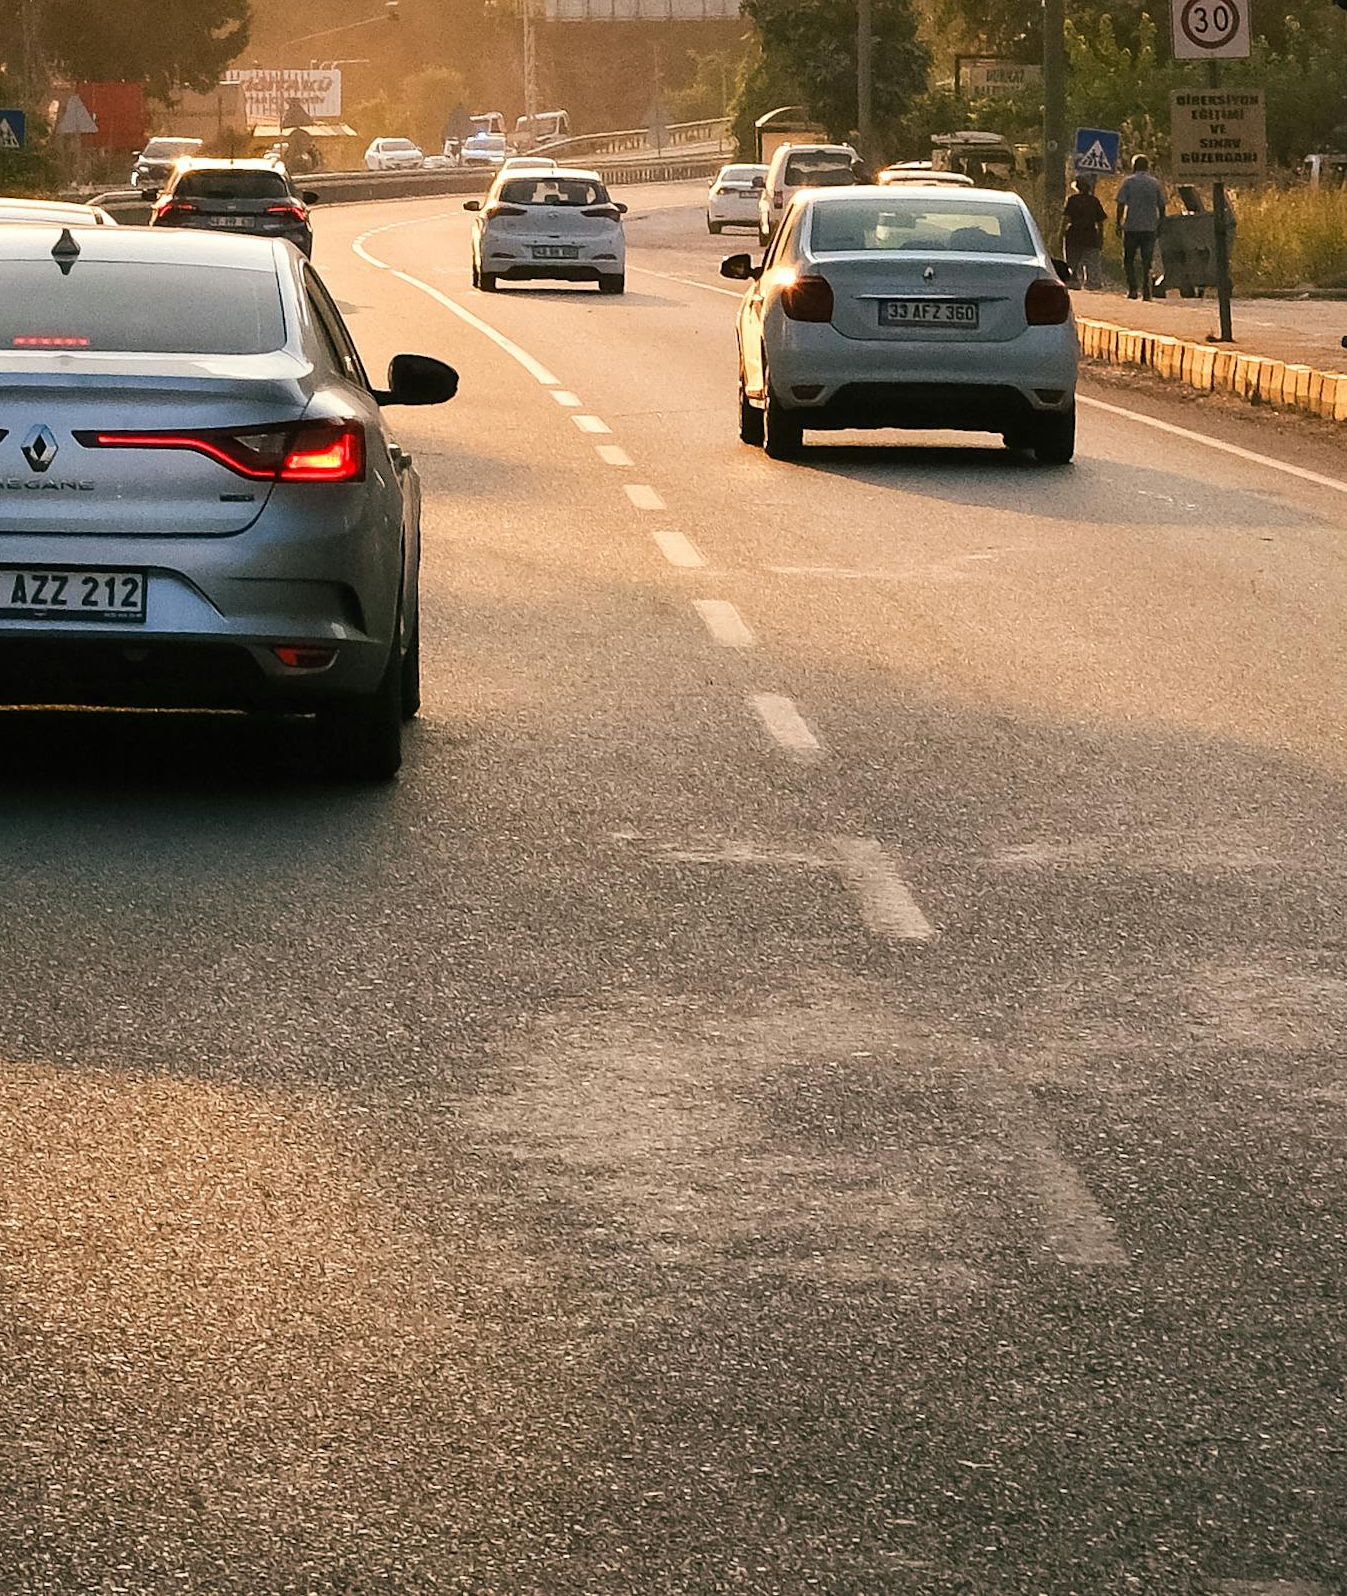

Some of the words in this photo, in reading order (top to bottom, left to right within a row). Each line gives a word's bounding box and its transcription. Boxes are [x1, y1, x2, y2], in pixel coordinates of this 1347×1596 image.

[1193, 6, 1229, 33] 30
[11, 574, 69, 605] AZZ
[81, 576, 140, 608] 212
